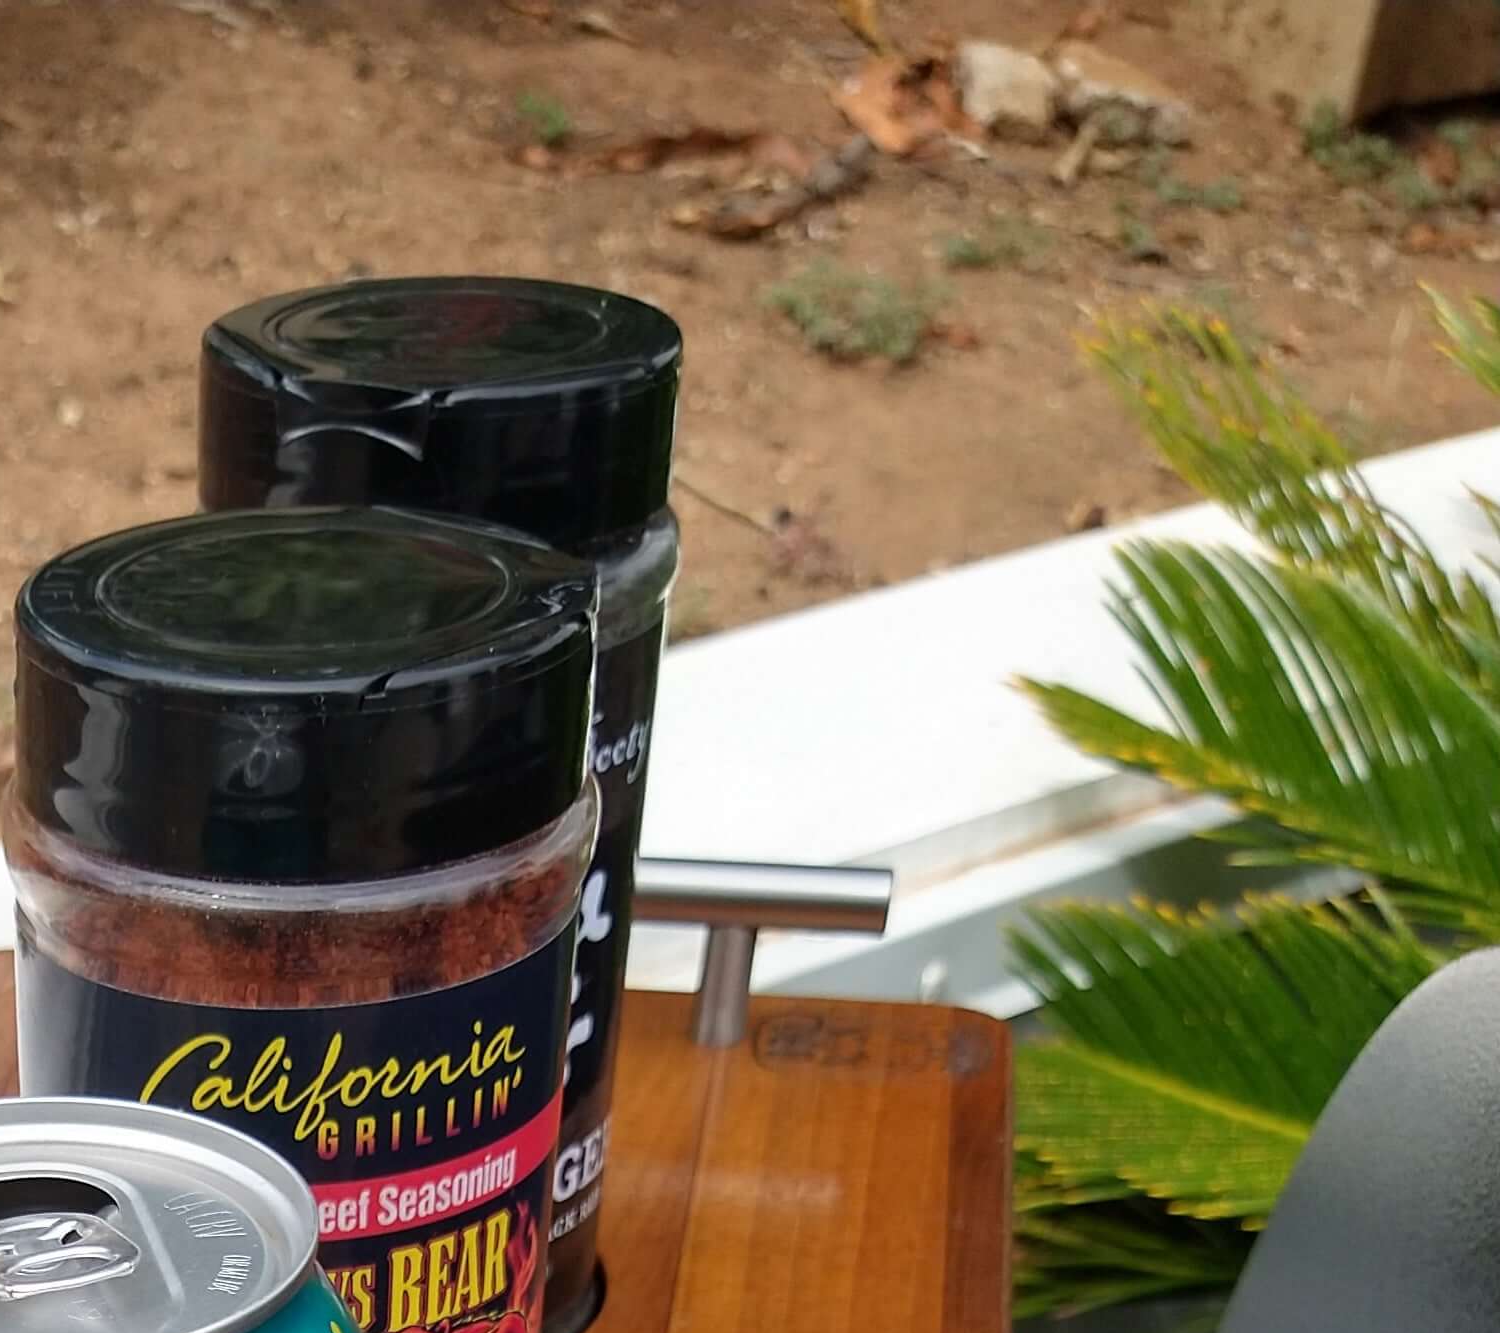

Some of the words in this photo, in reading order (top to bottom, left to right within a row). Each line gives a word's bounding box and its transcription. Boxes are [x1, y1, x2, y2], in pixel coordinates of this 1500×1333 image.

[139, 1019, 526, 1140] California
[316, 1066, 523, 1160] GRILLIN'
[318, 1188, 370, 1235] eef
[377, 1148, 517, 1226] Seasoning
[388, 1208, 512, 1333] BEAR
